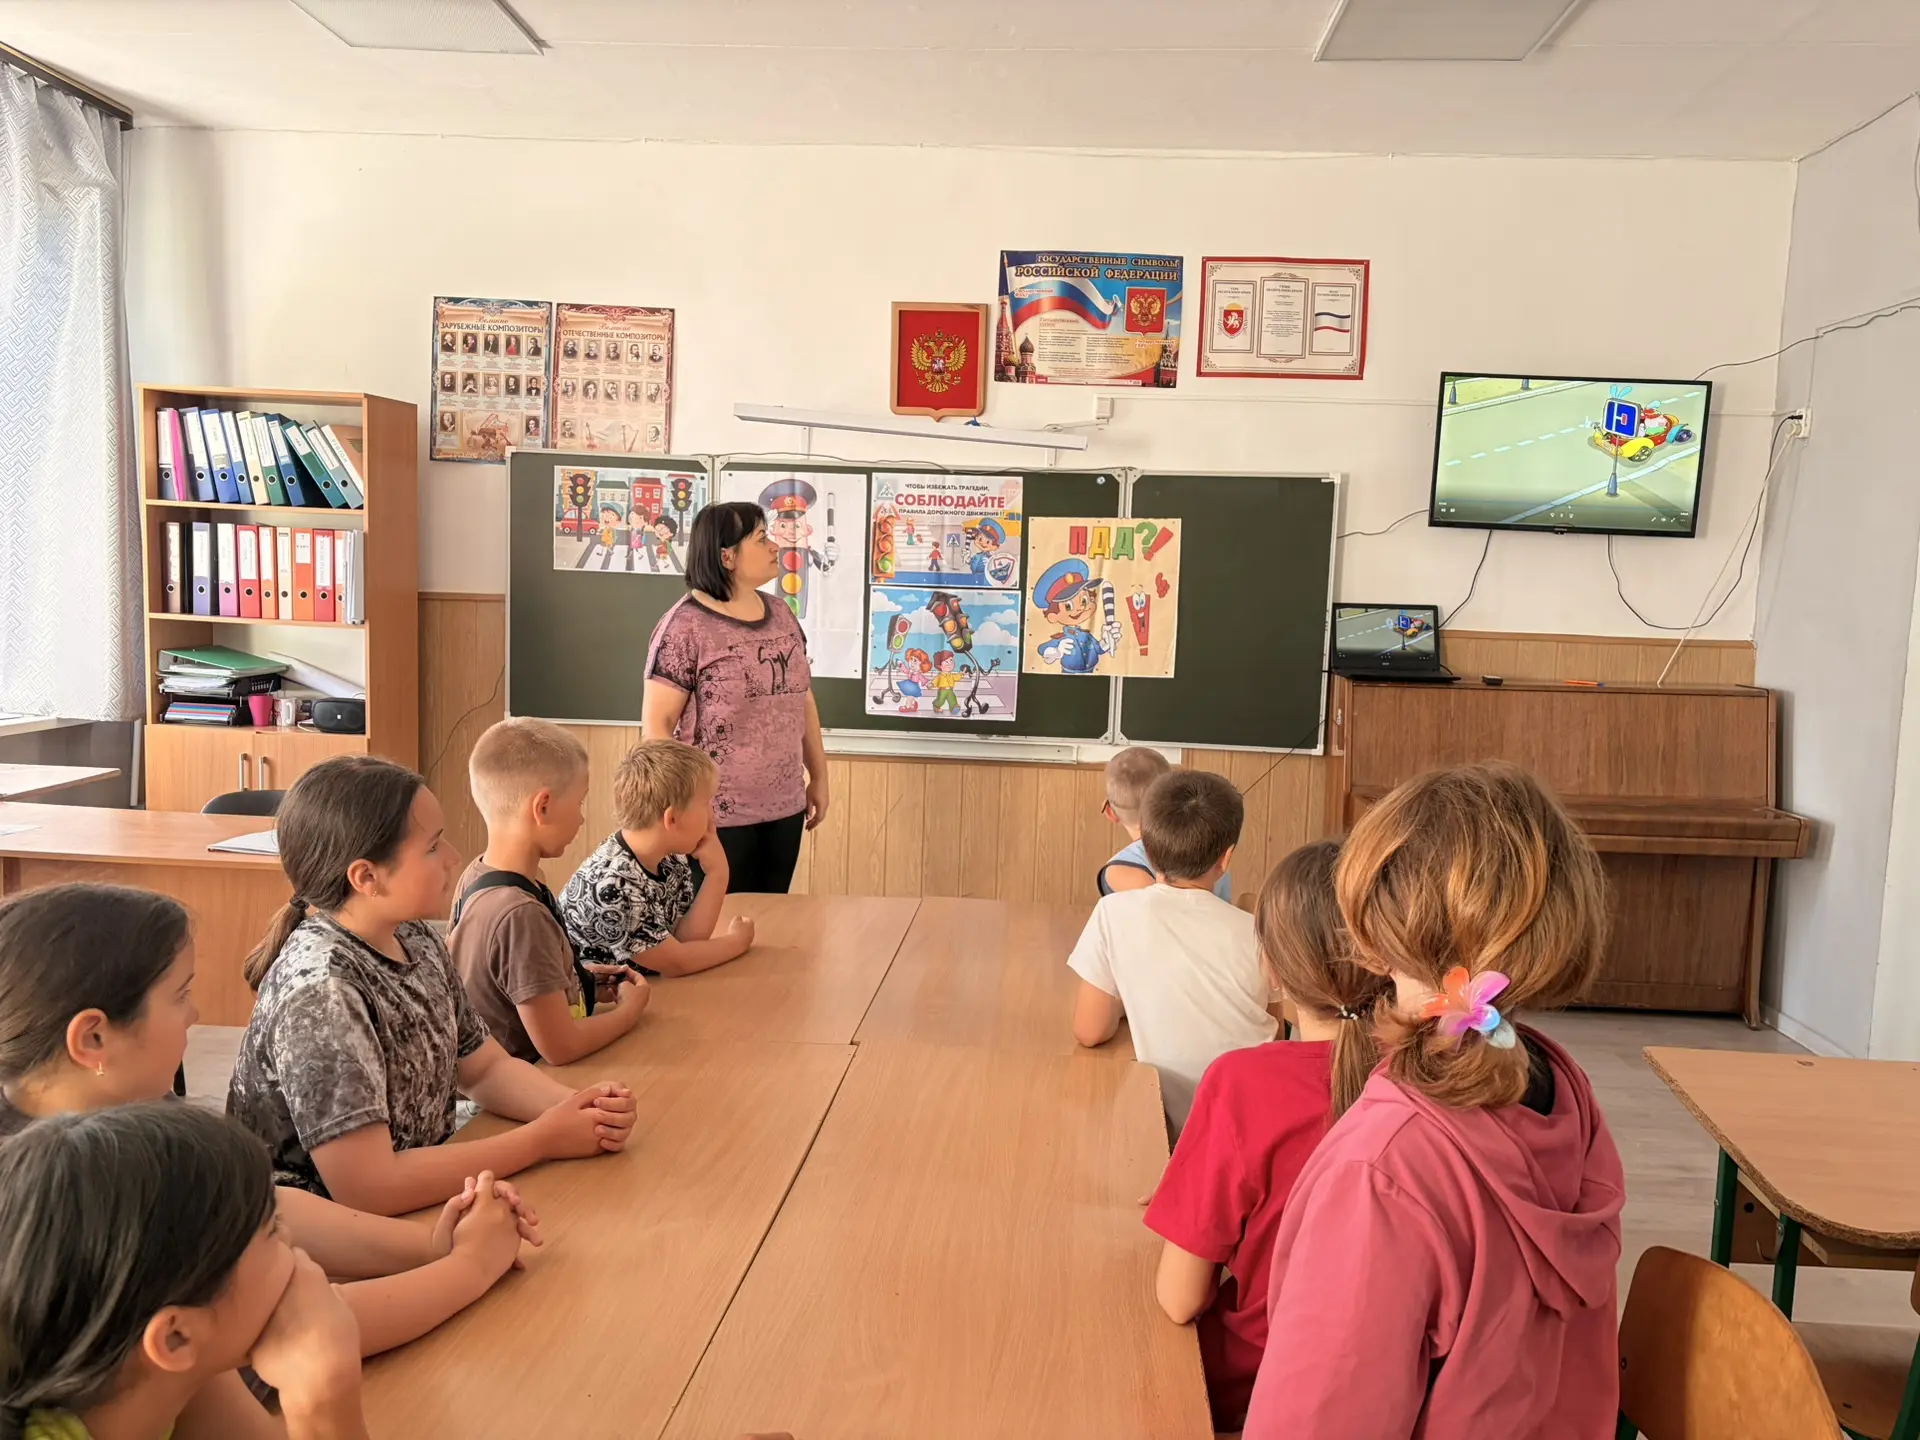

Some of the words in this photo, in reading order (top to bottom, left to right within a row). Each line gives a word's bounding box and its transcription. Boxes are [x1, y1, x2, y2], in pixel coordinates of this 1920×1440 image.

[1037, 254, 1127, 265] ГОСУДАРСТВЕННЫЕ
[1131, 257, 1179, 268] СИМВОЛЫ
[1016, 264, 1099, 278] РОССИЙСКОЙ
[1105, 268, 1178, 281] ФЕДЕРАЦИИ
[440, 322, 486, 331] ЗАРУБЕЖНЫЕ
[487, 324, 544, 333] КОМПОЗИТОРЫ
[562, 329, 615, 339] ОТЕЧЕСТВЕННЫЕ
[616, 332, 666, 341] КОМПОЗИТОРЫ
[895, 493, 1005, 509] СОБЛЮДАЙТЕ
